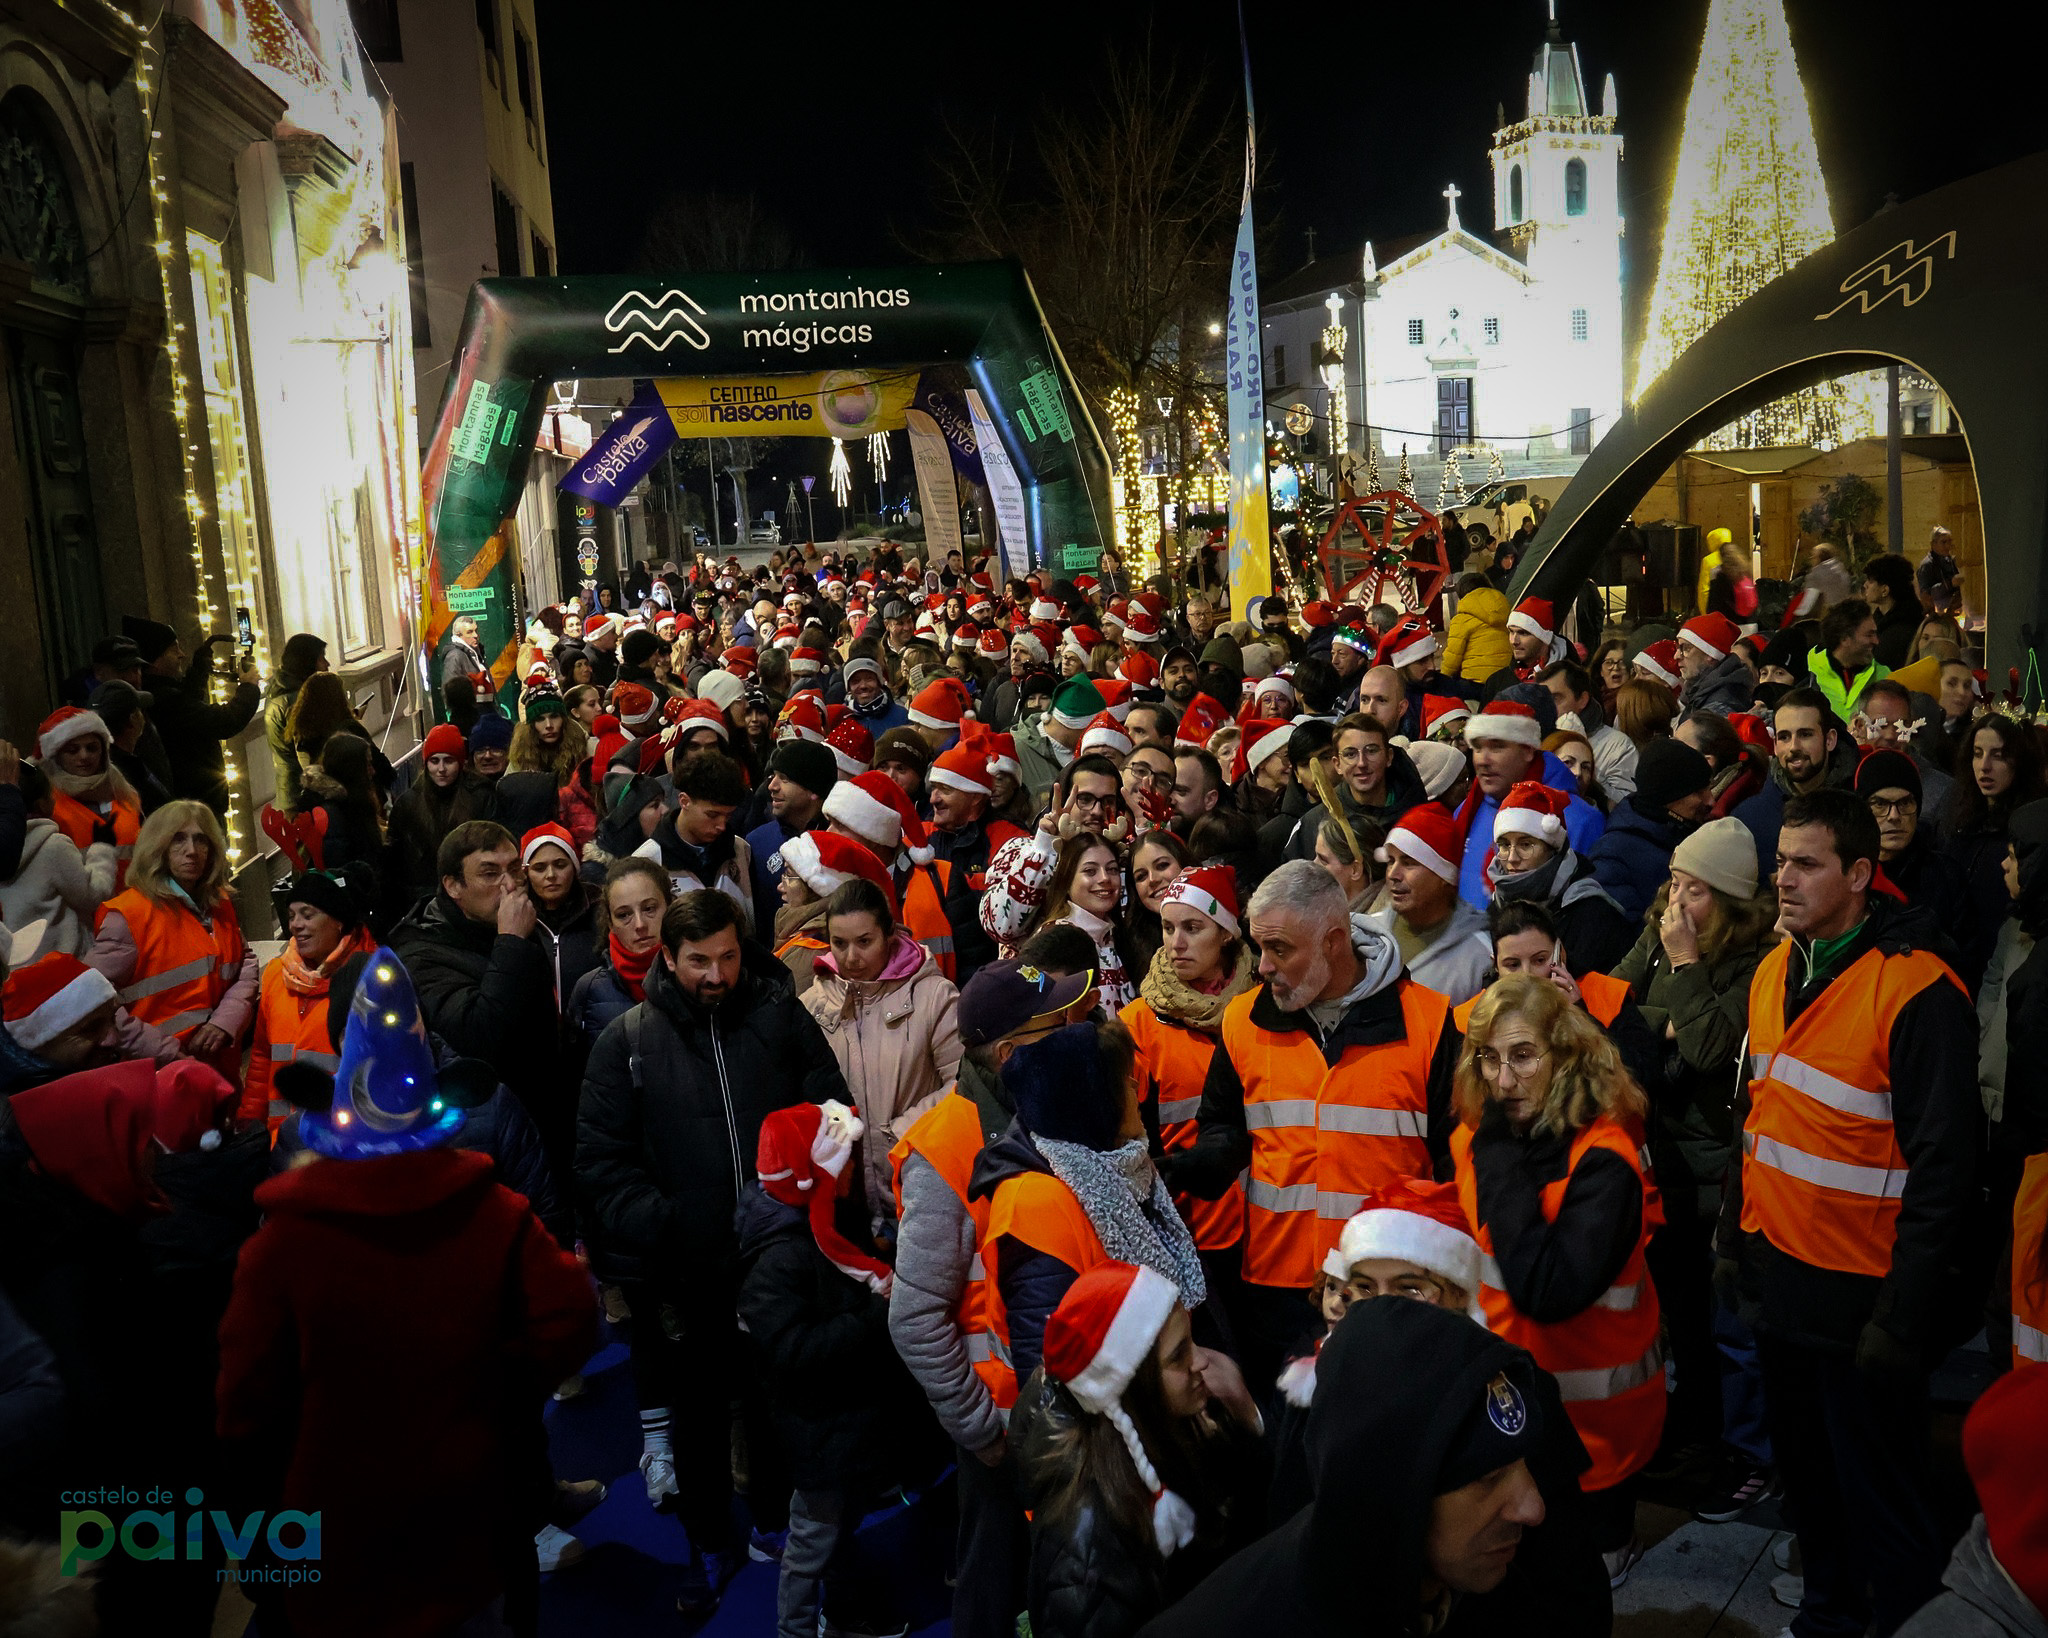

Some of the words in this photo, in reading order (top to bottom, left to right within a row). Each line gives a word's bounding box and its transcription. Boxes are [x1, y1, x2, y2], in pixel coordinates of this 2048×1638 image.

[741, 287, 909, 312] montanhas
[744, 322, 872, 354] mágicas
[710, 385, 777, 402] CENTRO
[941, 417, 977, 455] aiva
[601, 435, 647, 487] paiva
